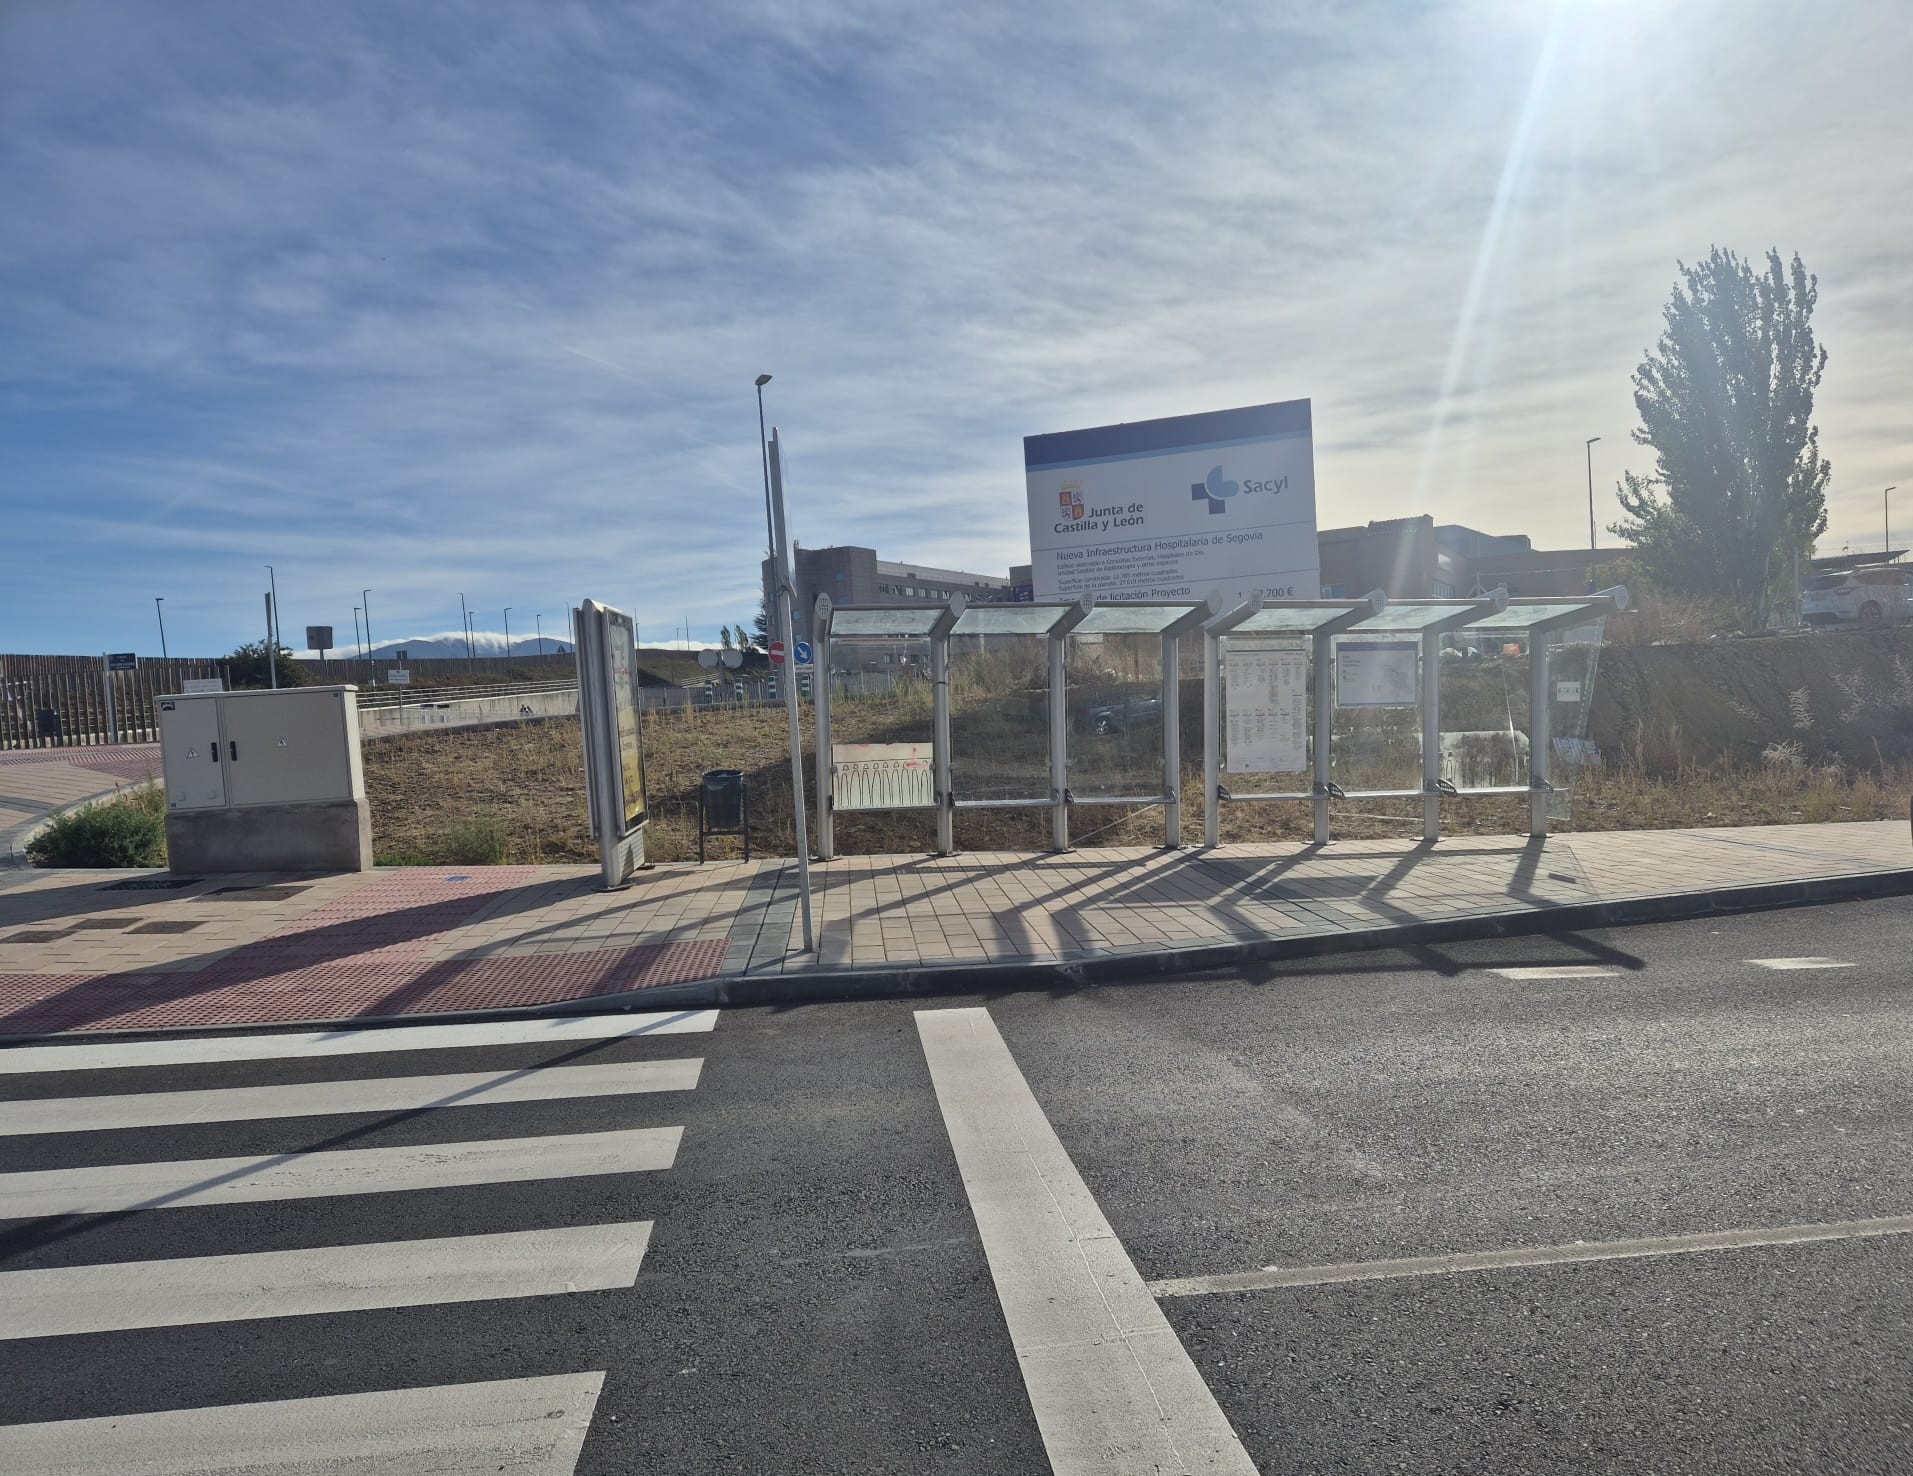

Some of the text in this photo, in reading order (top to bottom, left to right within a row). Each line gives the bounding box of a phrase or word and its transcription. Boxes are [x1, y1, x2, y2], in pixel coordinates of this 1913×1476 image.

[1243, 476, 1288, 494] Sacyl
[1088, 503, 1143, 518] Junta de
[1054, 515, 1144, 533] Castilla y León
[1056, 533, 1263, 560] Nueva Infraestructura Hospitalaria de Segovia
[1110, 589, 1149, 600] licitación
[1151, 587, 1191, 598] Proyecto
[1286, 586, 1294, 596] €
